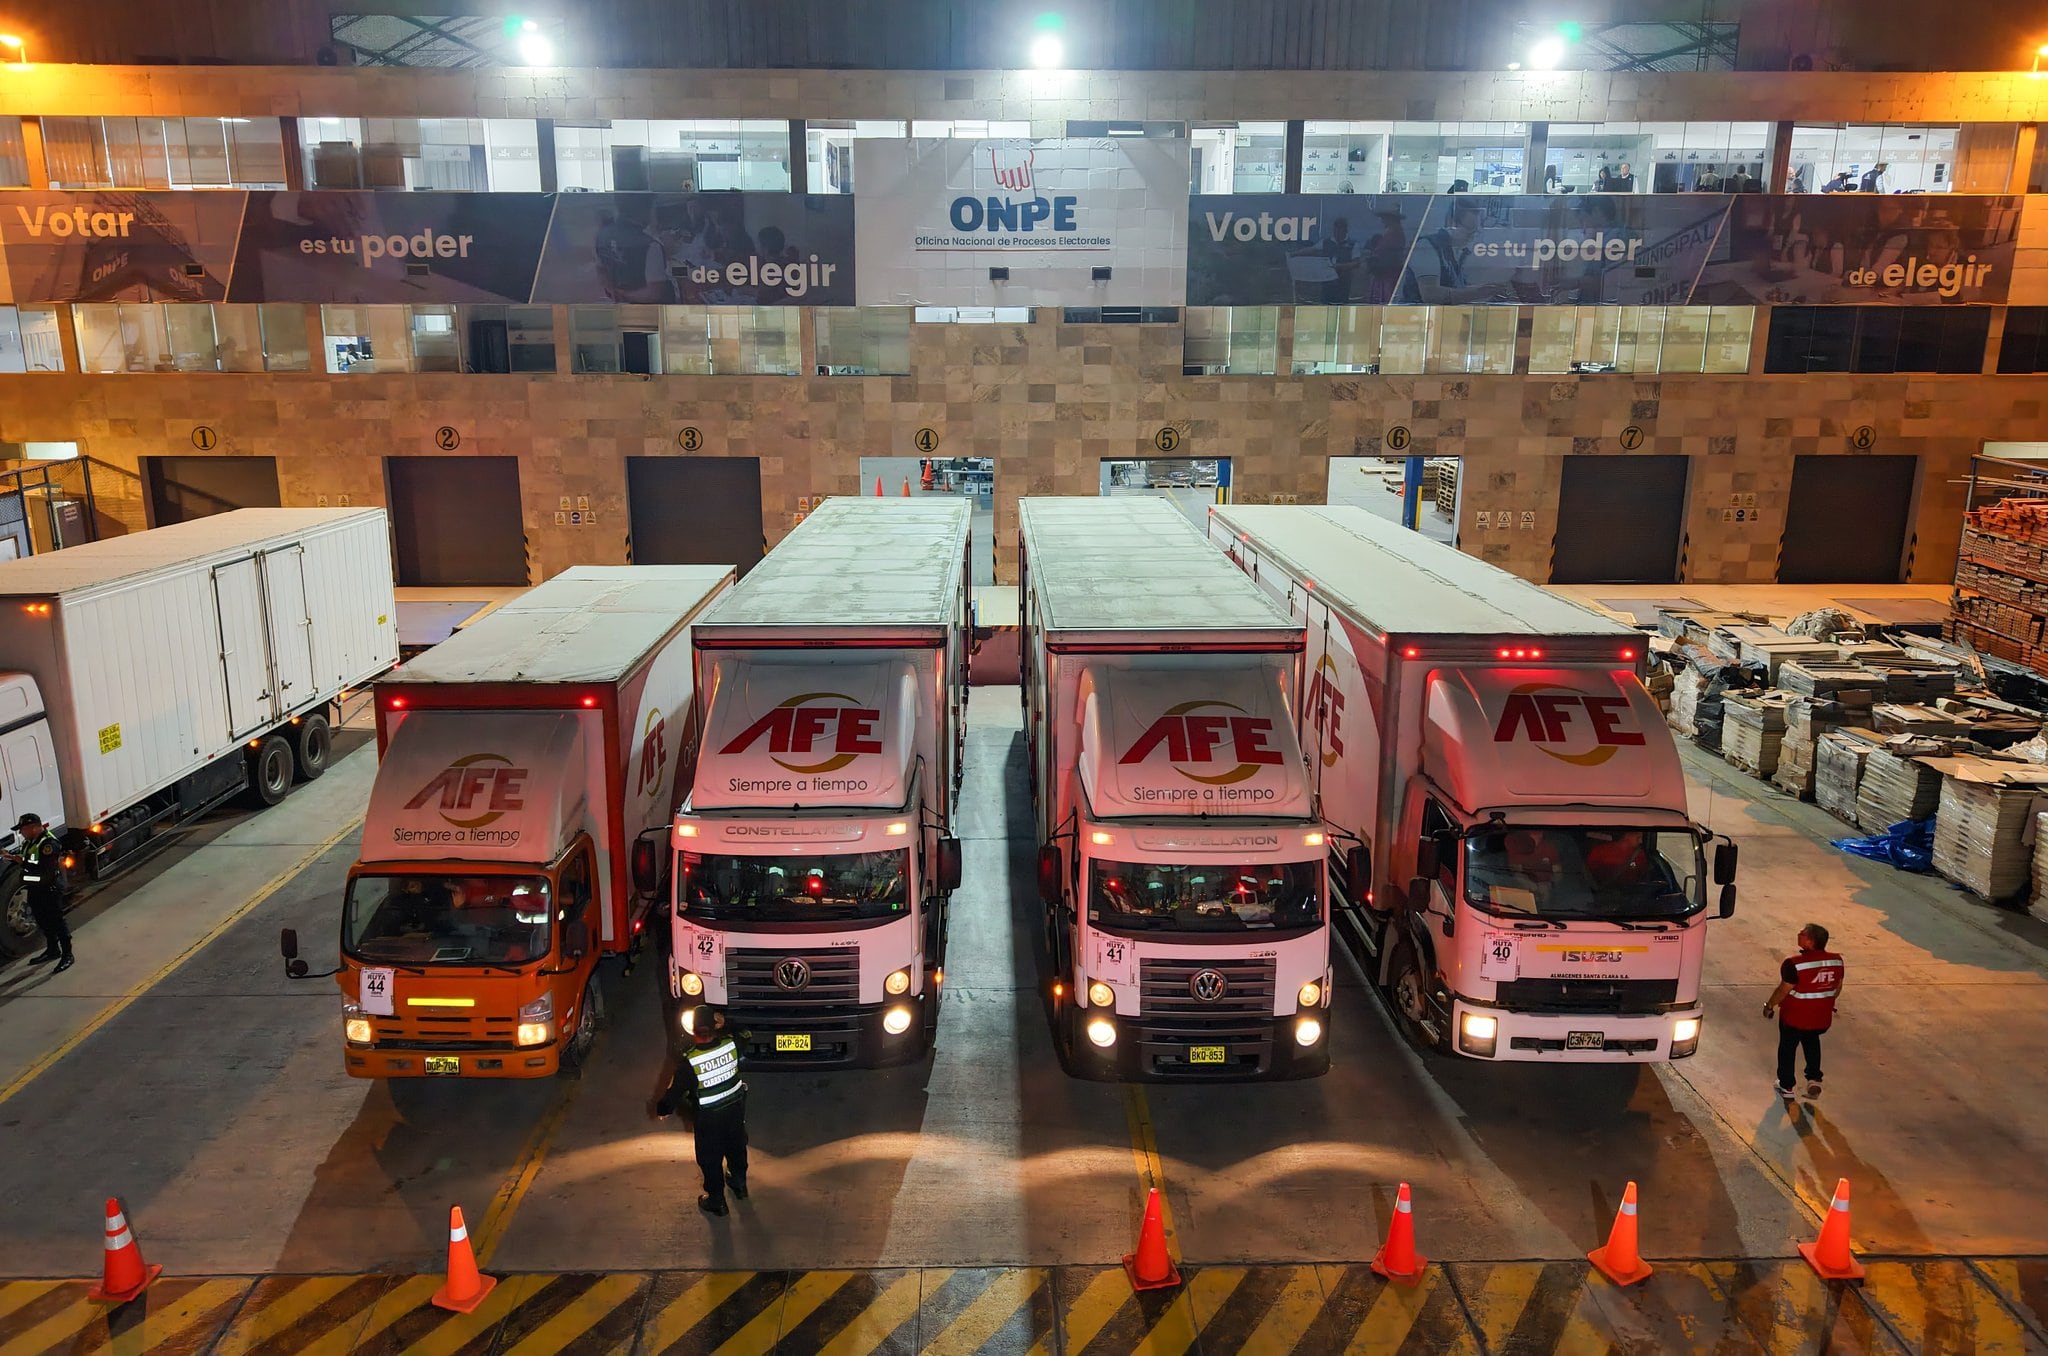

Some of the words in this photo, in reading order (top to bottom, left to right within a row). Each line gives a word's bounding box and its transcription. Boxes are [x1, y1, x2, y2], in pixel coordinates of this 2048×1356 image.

[16, 206, 134, 237] Votar
[950, 196, 1077, 232] ONPE
[1205, 211, 1317, 242] Votar
[300, 239, 326, 254] es
[330, 236, 355, 254] tu
[360, 228, 473, 268] poder
[915, 236, 950, 246] Oficina
[952, 237, 995, 247] Nacional
[997, 237, 1010, 246] de
[1012, 237, 1057, 246] Procesos
[1058, 236, 1111, 246] Electorales
[1473, 241, 1499, 257] es
[1503, 239, 1526, 257] tu
[1532, 232, 1643, 271] poder
[691, 265, 720, 284] de
[725, 254, 836, 297] elegir
[1849, 267, 1877, 285] de
[1882, 254, 1993, 297] elegir
[199, 429, 209, 448] 1
[442, 428, 454, 448] 2
[685, 429, 697, 448] 3
[920, 431, 932, 449] 4
[1162, 430, 1173, 449] 5
[1393, 429, 1404, 448] 6
[1626, 429, 1638, 448] 7
[1858, 428, 1869, 447] 8
[1494, 694, 1646, 746] AFE
[718, 707, 882, 754] AFE
[1118, 716, 1284, 765] AFE
[403, 768, 528, 810] AFE
[729, 778, 792, 794] Siempre
[796, 781, 807, 791] a
[812, 777, 868, 793] tiempo
[1134, 787, 1198, 802] Siempre
[1203, 789, 1214, 800] a
[1219, 786, 1275, 803] tiempo
[393, 828, 451, 843] Siempre
[455, 831, 465, 841] a
[470, 828, 520, 843] tiempo
[725, 825, 859, 836] CONSTELLATION
[697, 940, 714, 953] 42
[1107, 948, 1122, 960] 41
[1492, 946, 1511, 959] 40
[1562, 951, 1622, 962] ISUZU
[367, 980, 384, 992] 44
[1811, 971, 1836, 984] AFE
[777, 1038, 809, 1048] BKP-824
[699, 1052, 734, 1073] POLICIA
